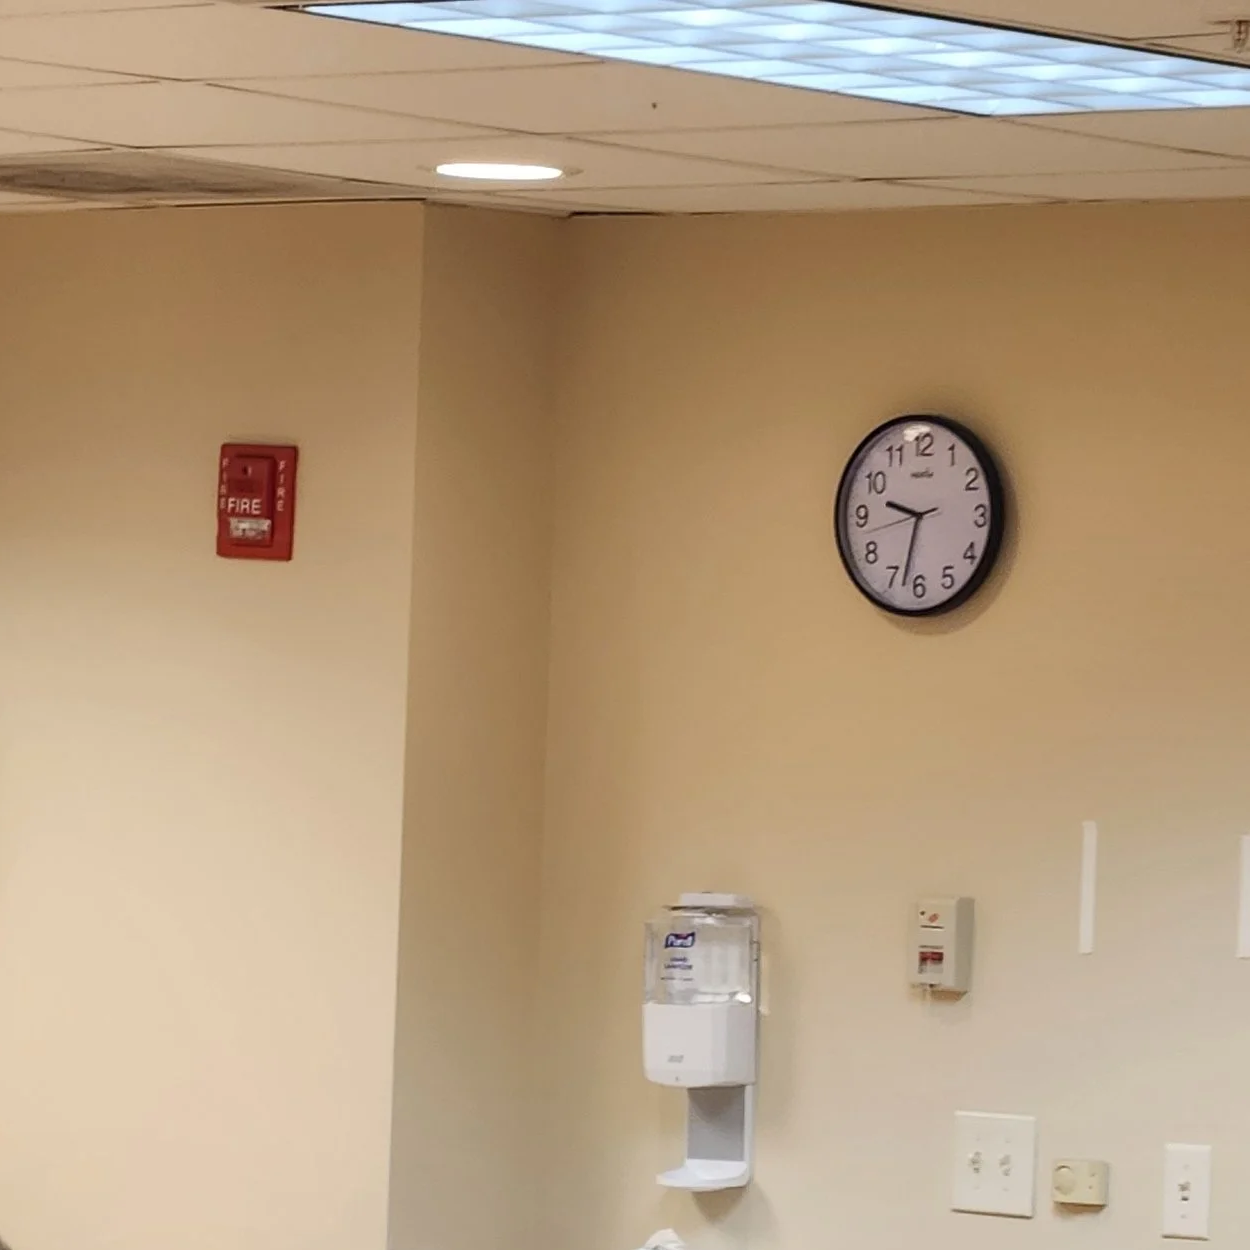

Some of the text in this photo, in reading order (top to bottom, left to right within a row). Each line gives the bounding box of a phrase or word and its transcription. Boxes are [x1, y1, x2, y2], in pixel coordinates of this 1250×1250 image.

[886, 444, 904, 467] 11
[914, 433, 935, 456] 12
[948, 443, 956, 466] 1
[277, 460, 286, 511] FIRE
[866, 471, 886, 494] 10
[965, 467, 979, 491] 2
[228, 497, 262, 514] FIRE
[855, 504, 869, 528] 9
[974, 504, 987, 528] 3
[865, 541, 878, 564] 8
[963, 542, 976, 565] 4
[886, 566, 899, 589] 7
[912, 575, 926, 598] 6
[941, 566, 954, 589] 5
